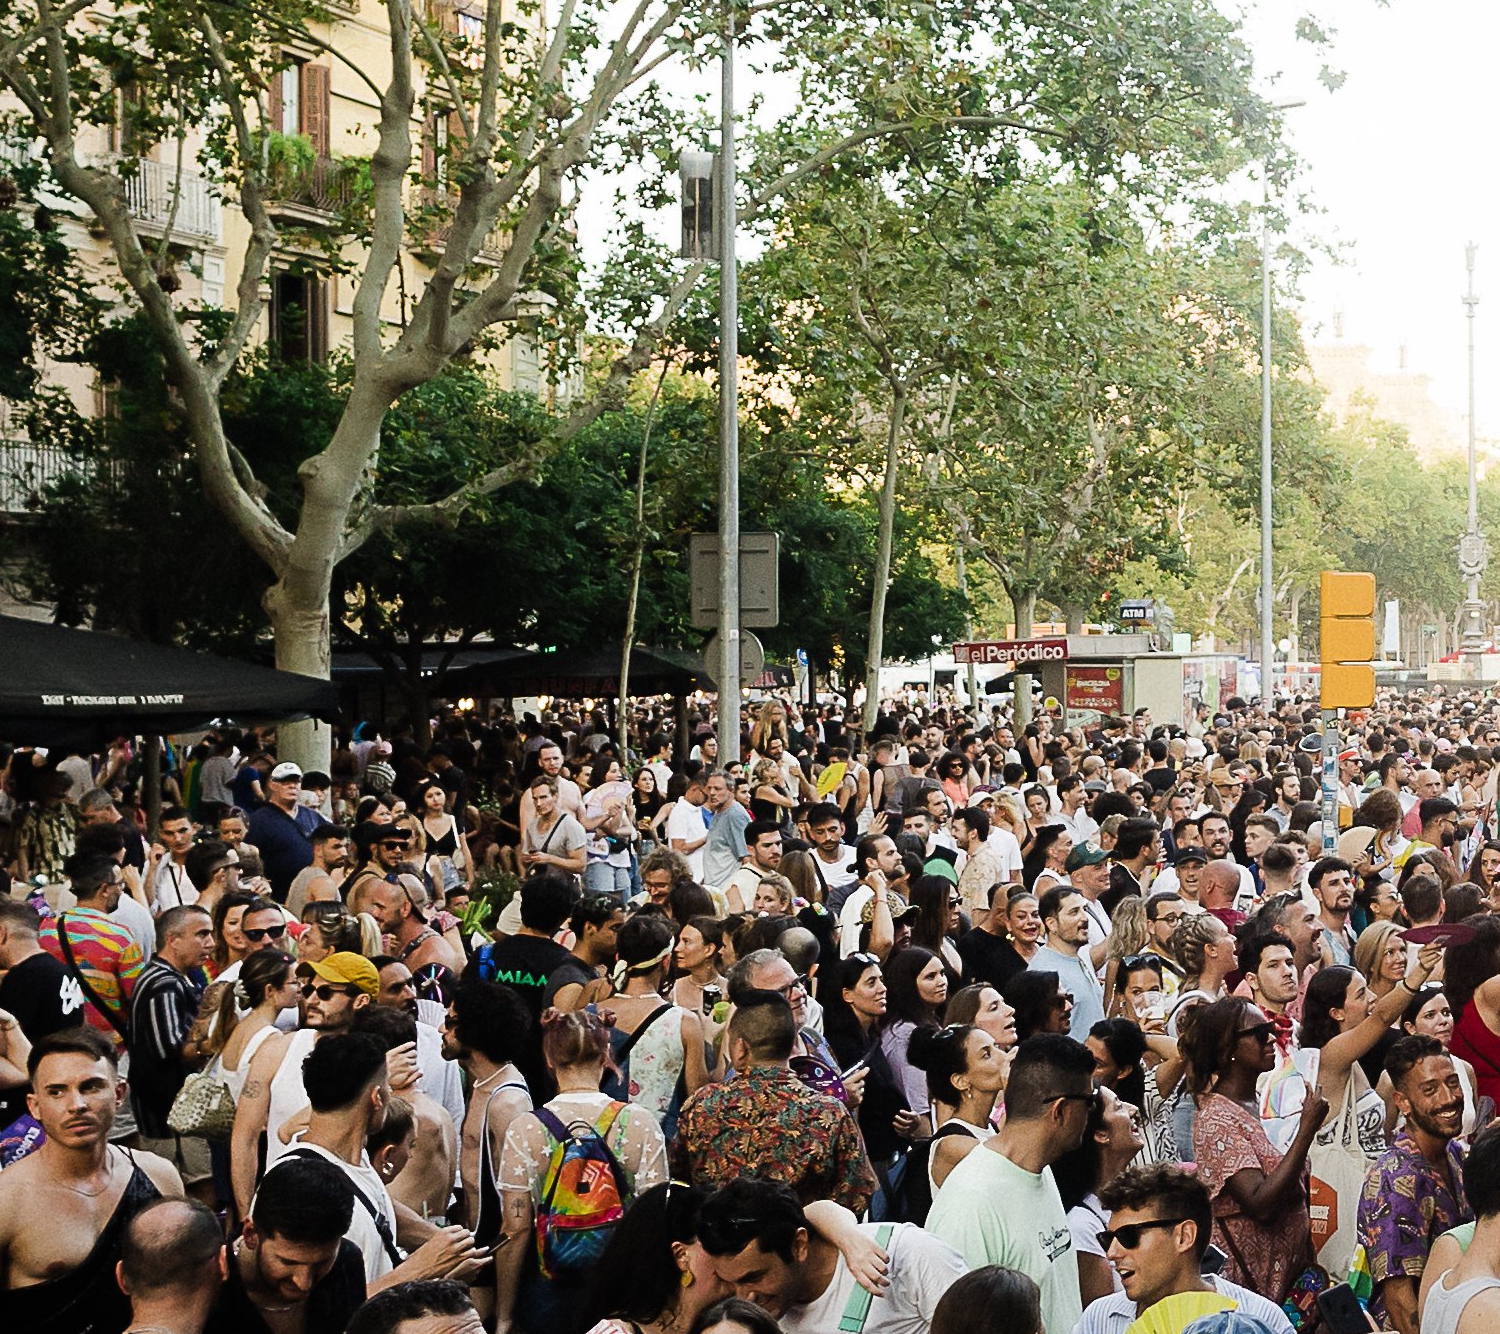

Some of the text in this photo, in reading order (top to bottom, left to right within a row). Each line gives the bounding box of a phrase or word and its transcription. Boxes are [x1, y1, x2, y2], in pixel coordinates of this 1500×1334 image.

[1122, 609, 1144, 618] ATM
[971, 643, 1065, 663] el Periódico
